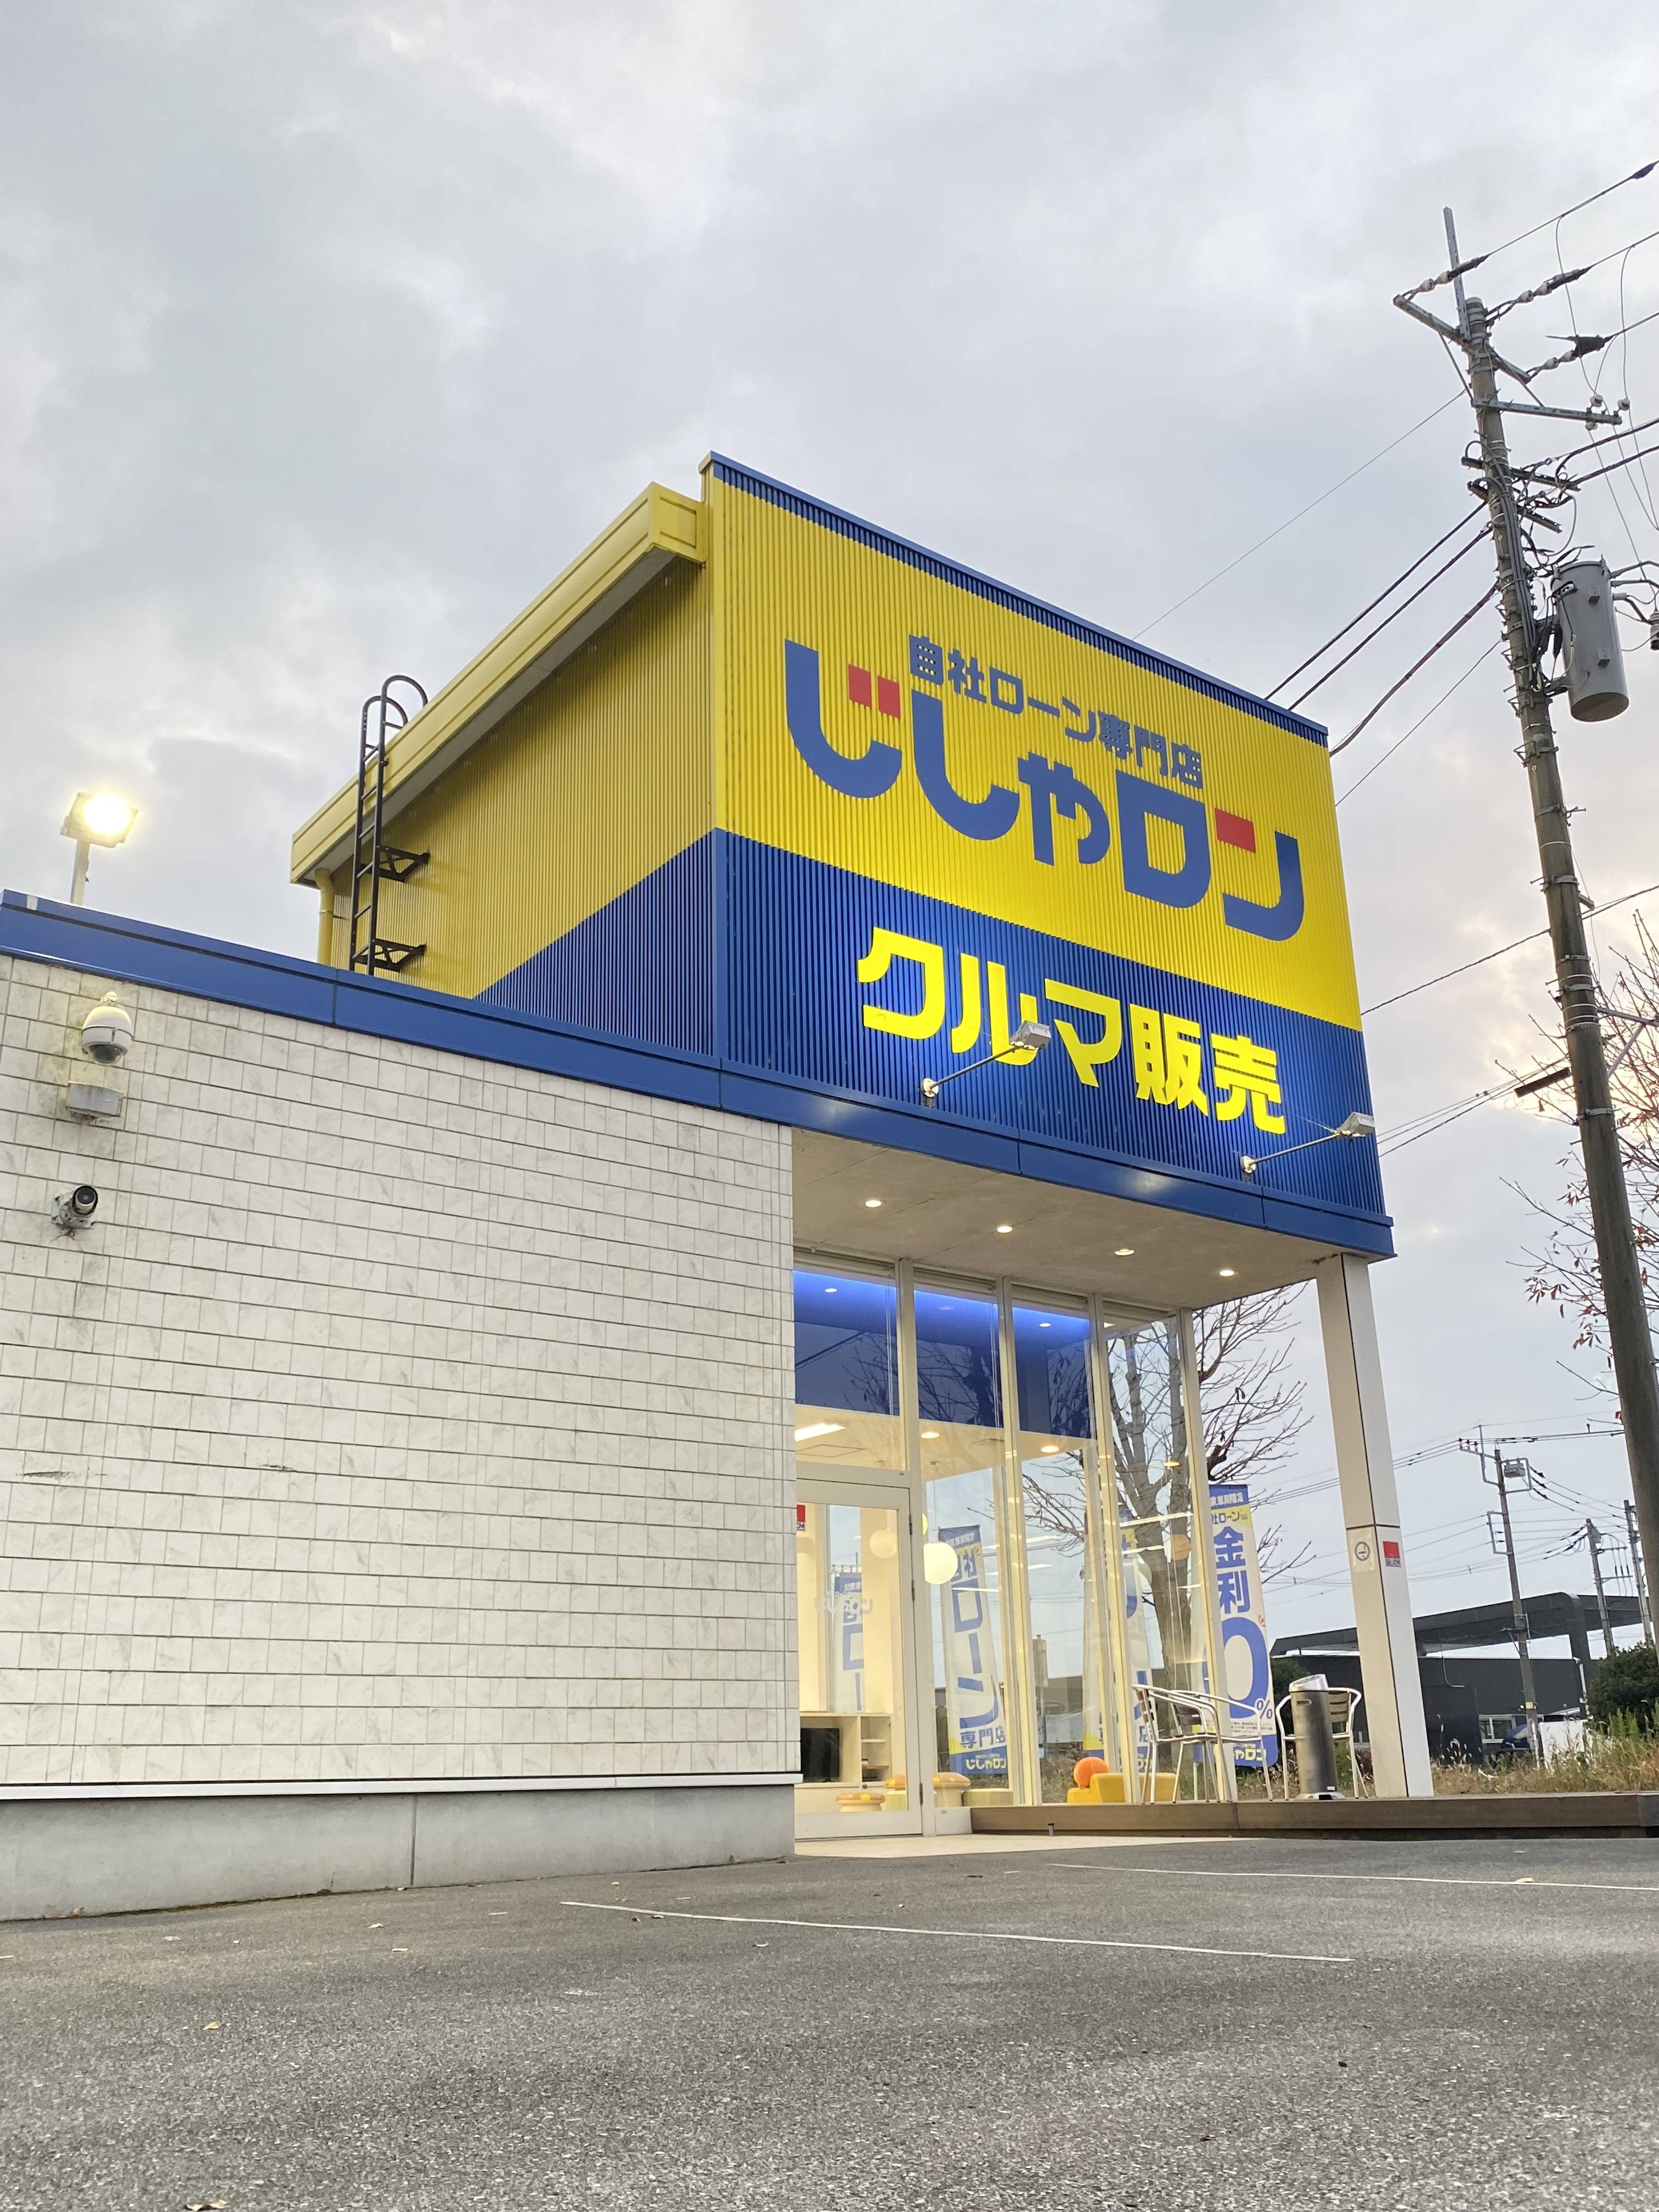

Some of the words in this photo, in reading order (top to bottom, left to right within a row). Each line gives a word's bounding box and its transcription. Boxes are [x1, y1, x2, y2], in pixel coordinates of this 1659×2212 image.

[785, 639, 1304, 941] じしゃロン
[910, 635, 1203, 788] 自社ローン専門店
[857, 927, 1286, 1135] クルマ販売
